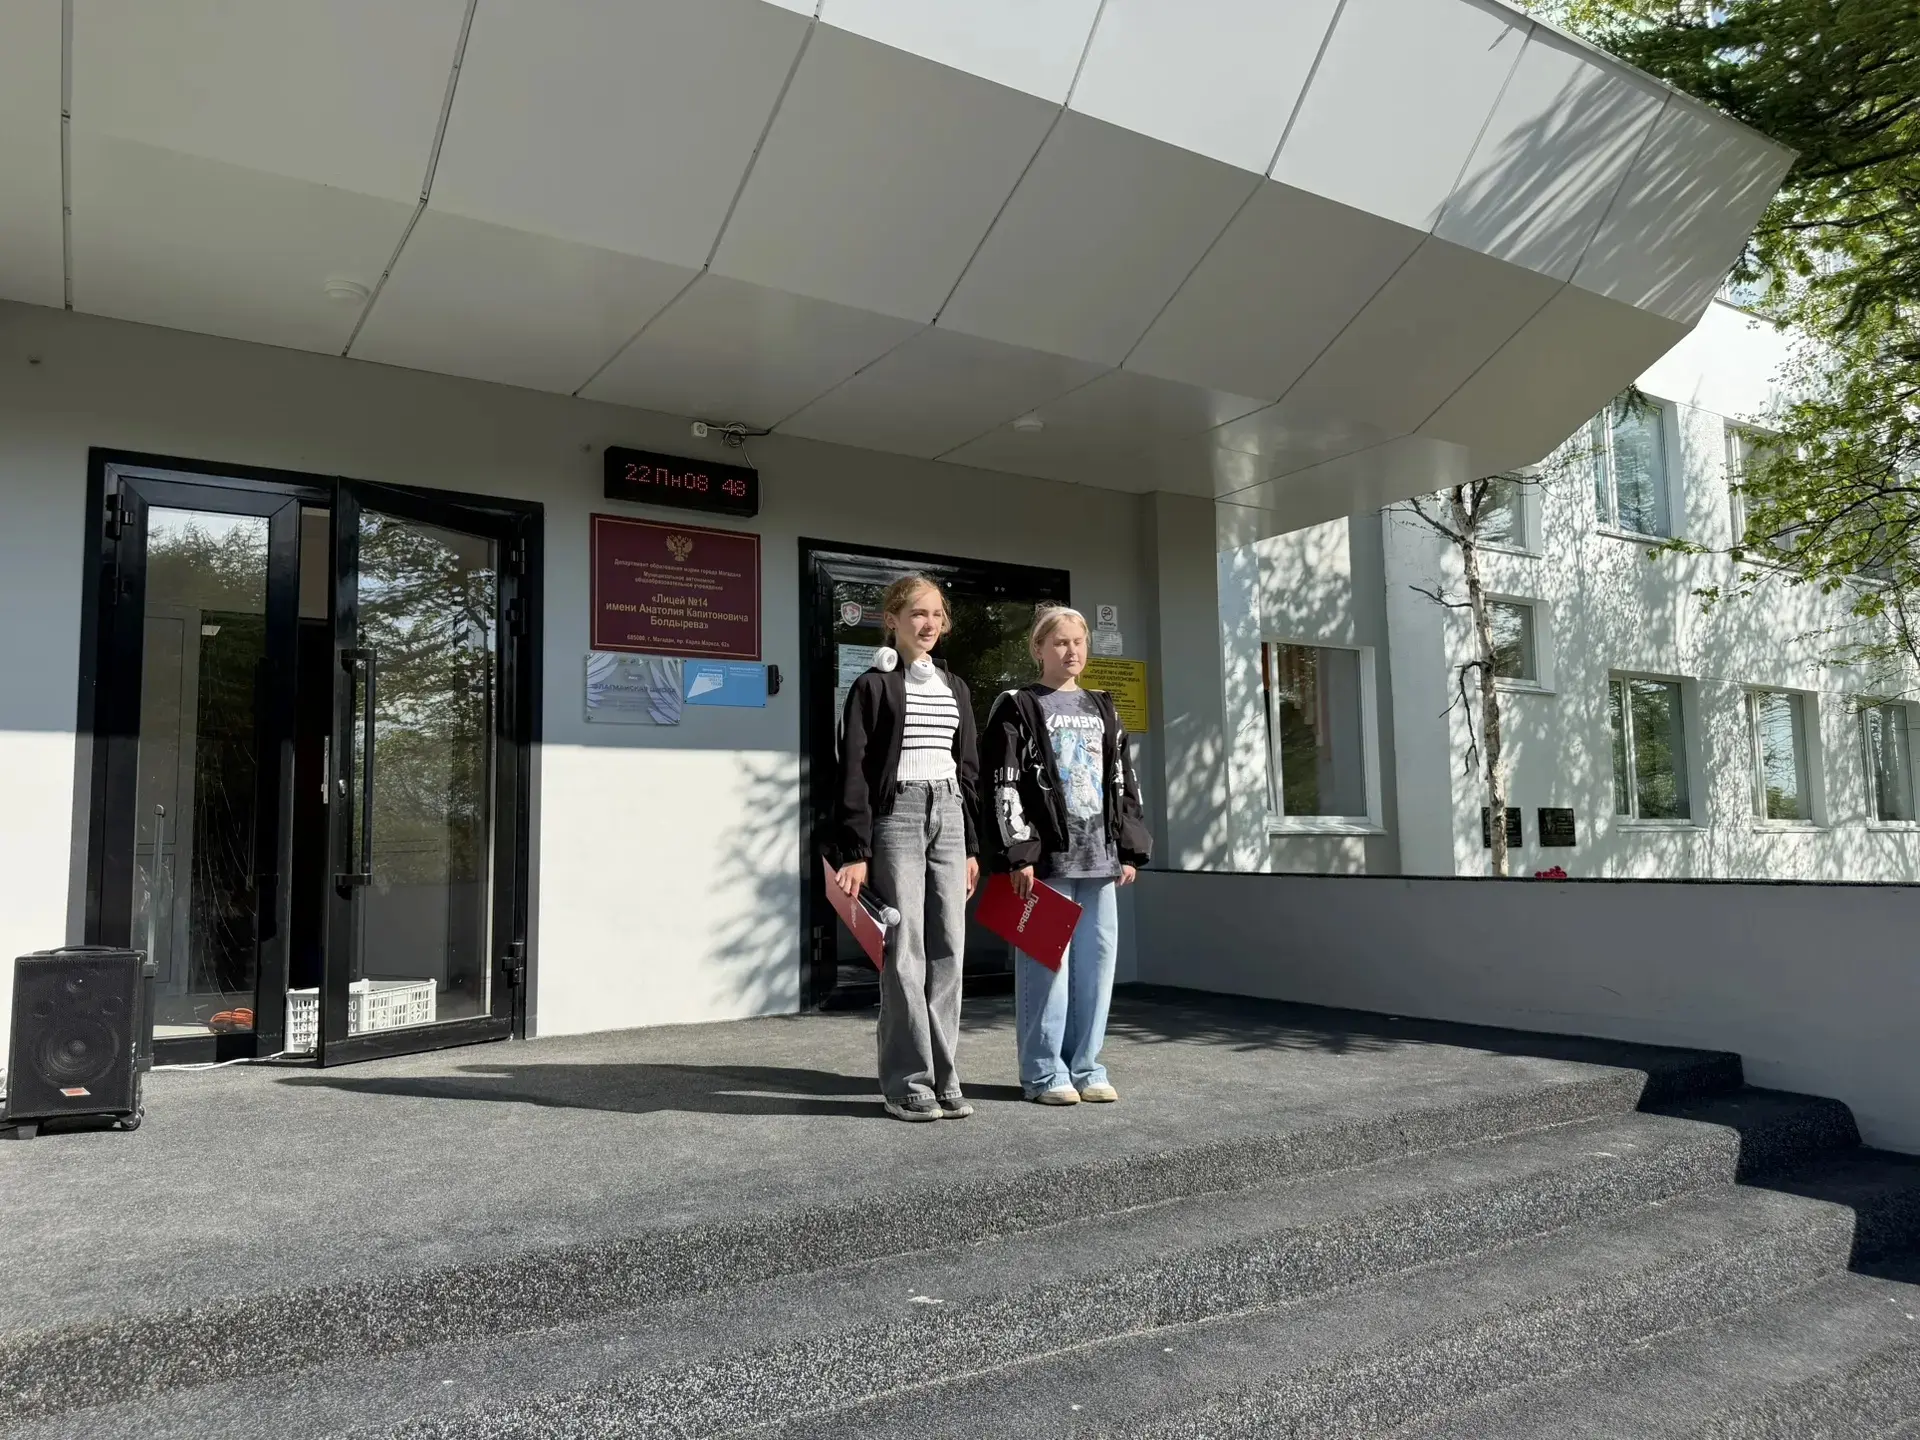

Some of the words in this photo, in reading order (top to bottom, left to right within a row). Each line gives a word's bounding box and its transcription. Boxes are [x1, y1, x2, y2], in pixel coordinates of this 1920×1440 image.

[624, 463, 650, 482] 22
[656, 467, 680, 488] Пн
[684, 472, 708, 491] 08
[722, 479, 746, 497] 48
[651, 593, 686, 606] «Лицей
[687, 596, 708, 607] №14
[605, 602, 637, 613] имени
[639, 603, 685, 616] Анатолия
[686, 607, 749, 622] Капитоновича
[650, 615, 709, 630] Болдырева»
